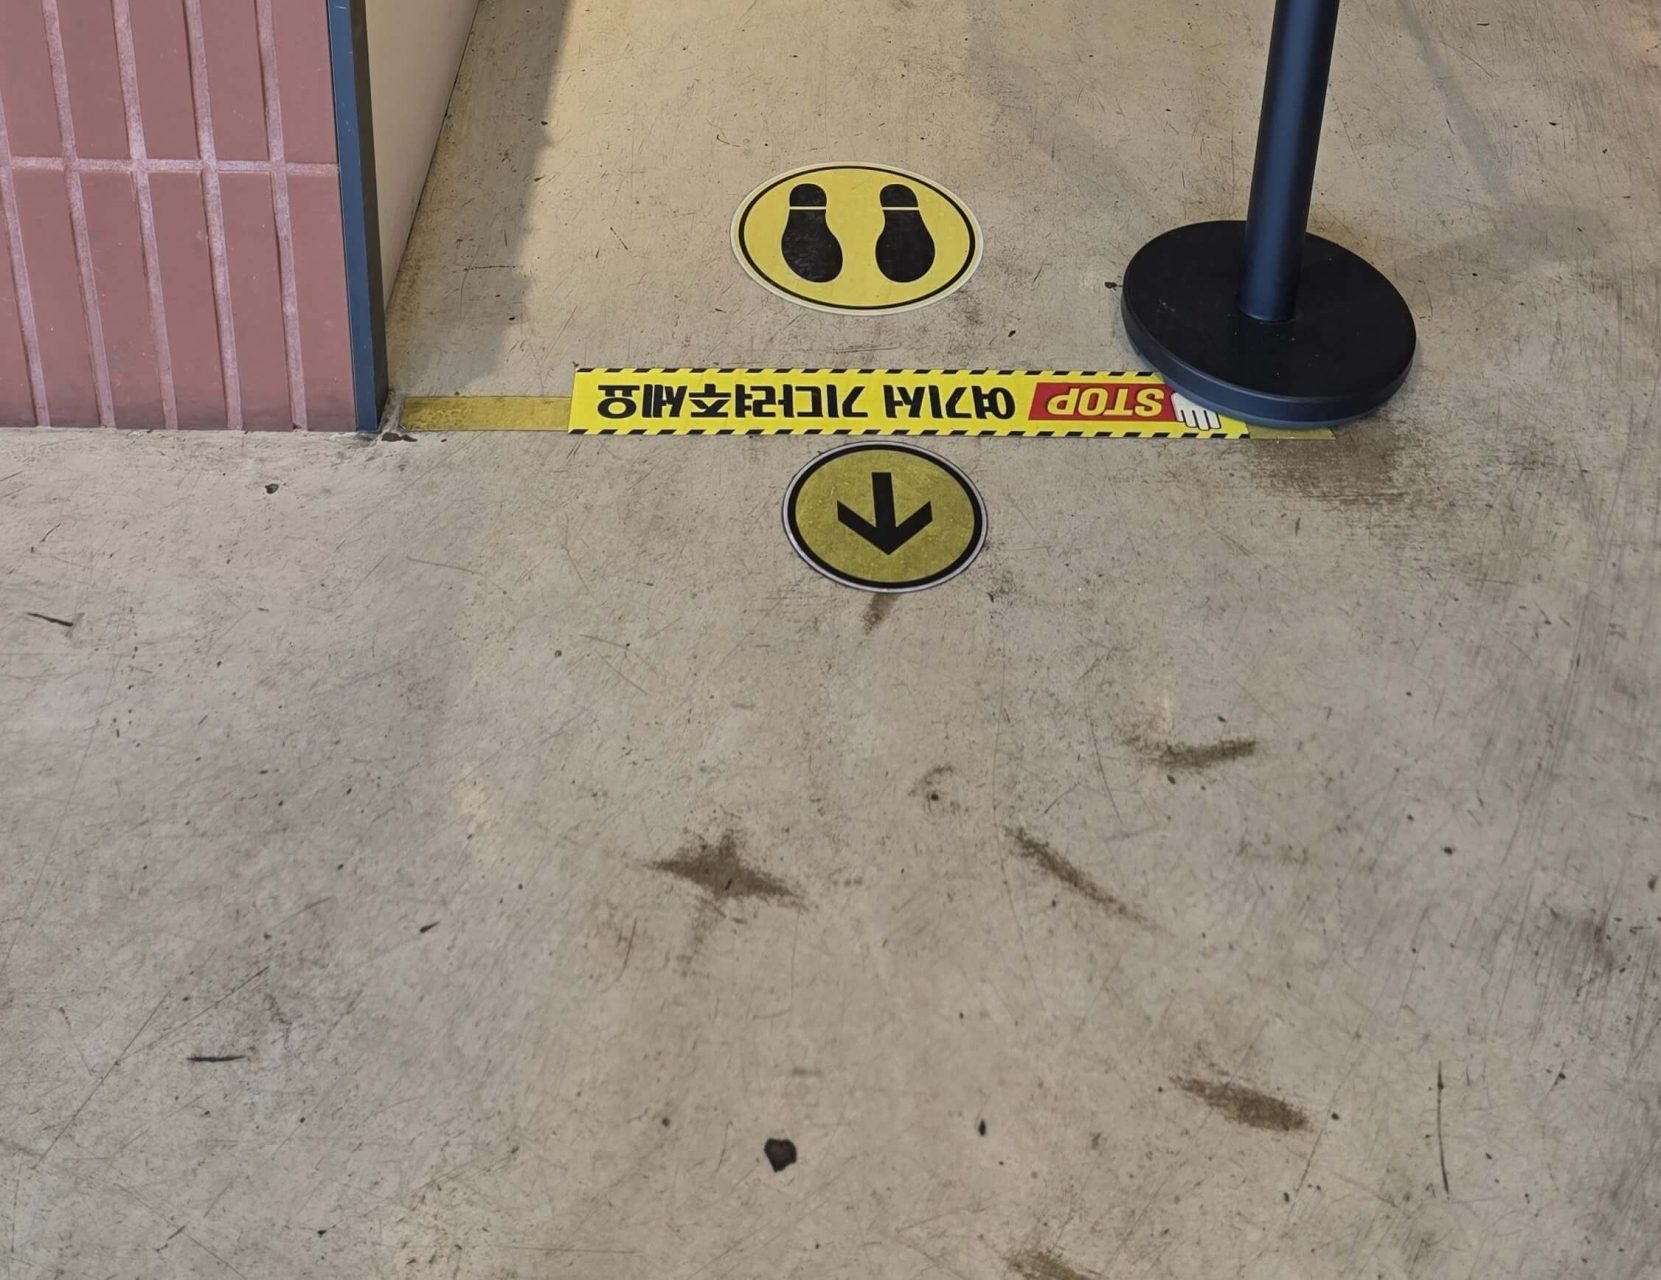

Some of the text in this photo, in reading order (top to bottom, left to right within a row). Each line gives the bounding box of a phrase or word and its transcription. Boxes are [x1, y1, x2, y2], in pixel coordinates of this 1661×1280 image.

[597, 384, 1165, 420] STOP 여기서 기다려주세요
